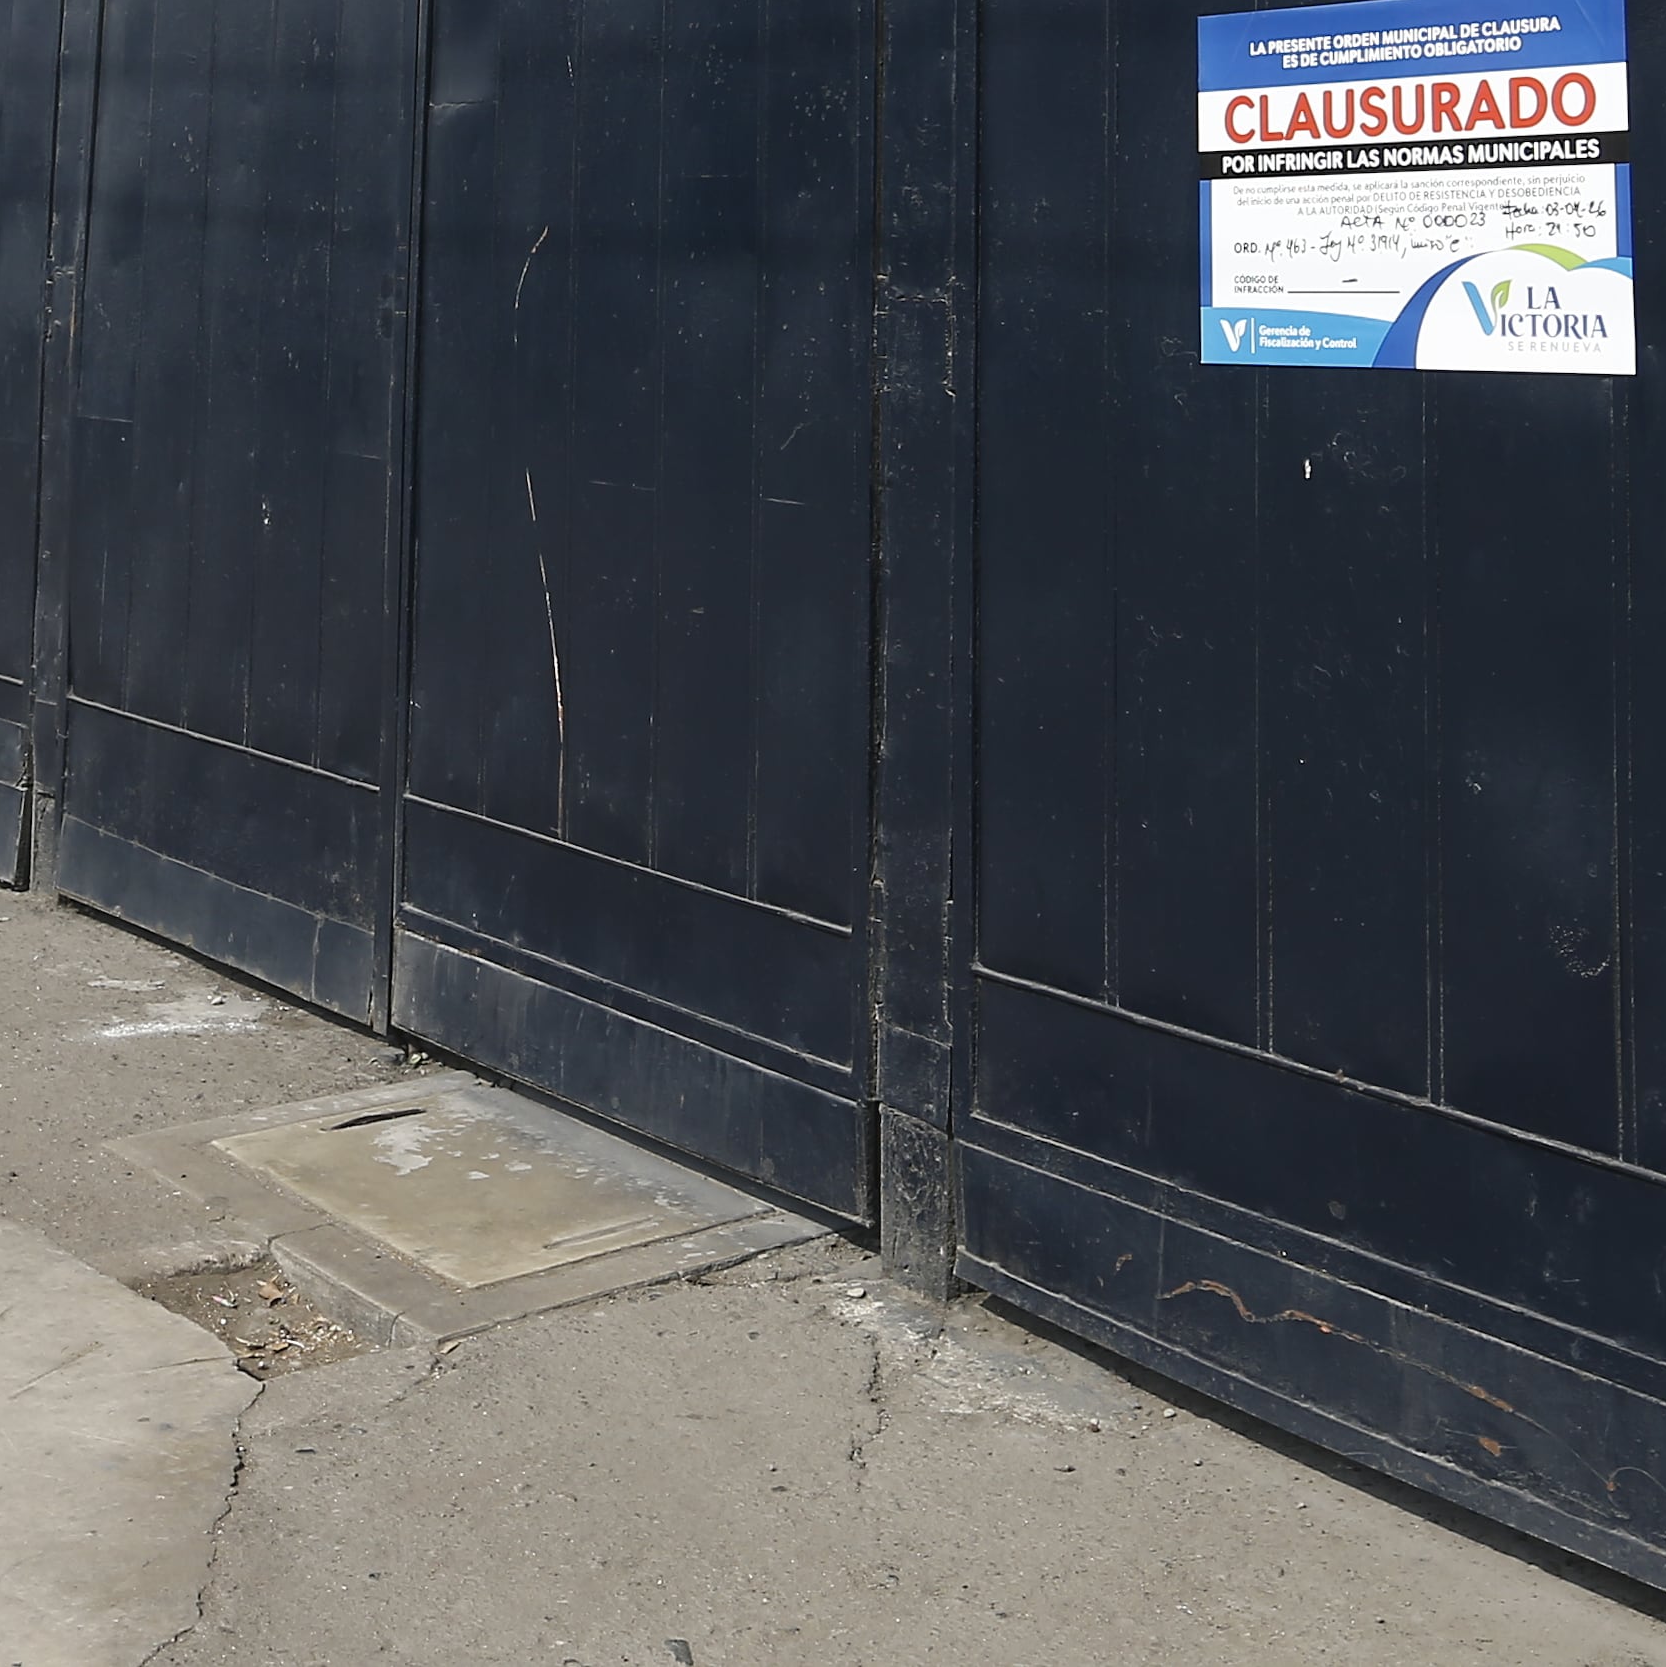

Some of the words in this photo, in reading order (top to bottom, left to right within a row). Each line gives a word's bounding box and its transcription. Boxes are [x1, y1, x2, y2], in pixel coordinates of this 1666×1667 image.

[1249, 41, 1267, 56] LA
[1267, 36, 1332, 54] PRESENTE
[1333, 31, 1379, 48] ORDEN
[1382, 25, 1458, 45] MUNICIPAL
[1460, 23, 1480, 39] DE
[1481, 16, 1561, 36] CLAUSURA
[1282, 54, 1299, 69] ES
[1300, 53, 1319, 67] DE
[1319, 44, 1422, 66] CUMPLIMIENTO
[1424, 36, 1522, 57] OBLIGATORIO
[1224, 72, 1597, 144] CLAUSURADO
[1222, 155, 1255, 174] POR
[1257, 151, 1343, 172] INFRINGIR
[1346, 148, 1380, 169] LAS
[1384, 145, 1464, 166] NORMAS
[1468, 139, 1600, 163] MUNICIPALES
[1233, 186, 1244, 195] De
[1257, 184, 1296, 197] cumplirse
[1297, 184, 1316, 193] esta
[1317, 182, 1351, 193] medida,
[1364, 181, 1399, 192] aplicará
[1400, 180, 1409, 189] la
[1411, 178, 1444, 189] sanción
[1445, 176, 1526, 190] correspondiente,
[1527, 175, 1541, 185] sin
[1543, 174, 1586, 188] perjuicio
[1236, 196, 1250, 206] del
[1250, 196, 1271, 205] inicio
[1273, 195, 1284, 204] de
[1302, 194, 1329, 204] acción
[1330, 193, 1354, 205] penal
[1356, 194, 1371, 205] por
[1373, 191, 1407, 202] DELITO
[1409, 191, 1421, 200] DE
[1423, 189, 1486, 200] RESISTENCIA
[1489, 189, 1496, 198] Y
[1498, 186, 1581, 198] DESOBEDIENCIA
[1297, 207, 1304, 215] A
[1306, 207, 1318, 215] LA
[1319, 205, 1373, 215] AUTORIDAD
[1374, 204, 1405, 216] (Según
[1406, 203, 1439, 214] Código
[1441, 202, 1467, 212] Penal
[1234, 242, 1261, 254] ORD.
[1234, 274, 1267, 284] CÓDIGO
[1268, 274, 1279, 284] DE
[1234, 285, 1284, 294] INFRACCIÓN
[1526, 286, 1561, 310] LA
[1259, 325, 1298, 337] Gerencia
[1299, 324, 1311, 337] de
[1259, 336, 1314, 349] Fiscalización
[1315, 339, 1322, 351] y
[1322, 337, 1358, 350] Control
[1508, 340, 1525, 352] SE
[1529, 341, 1602, 353] RENUEVA
